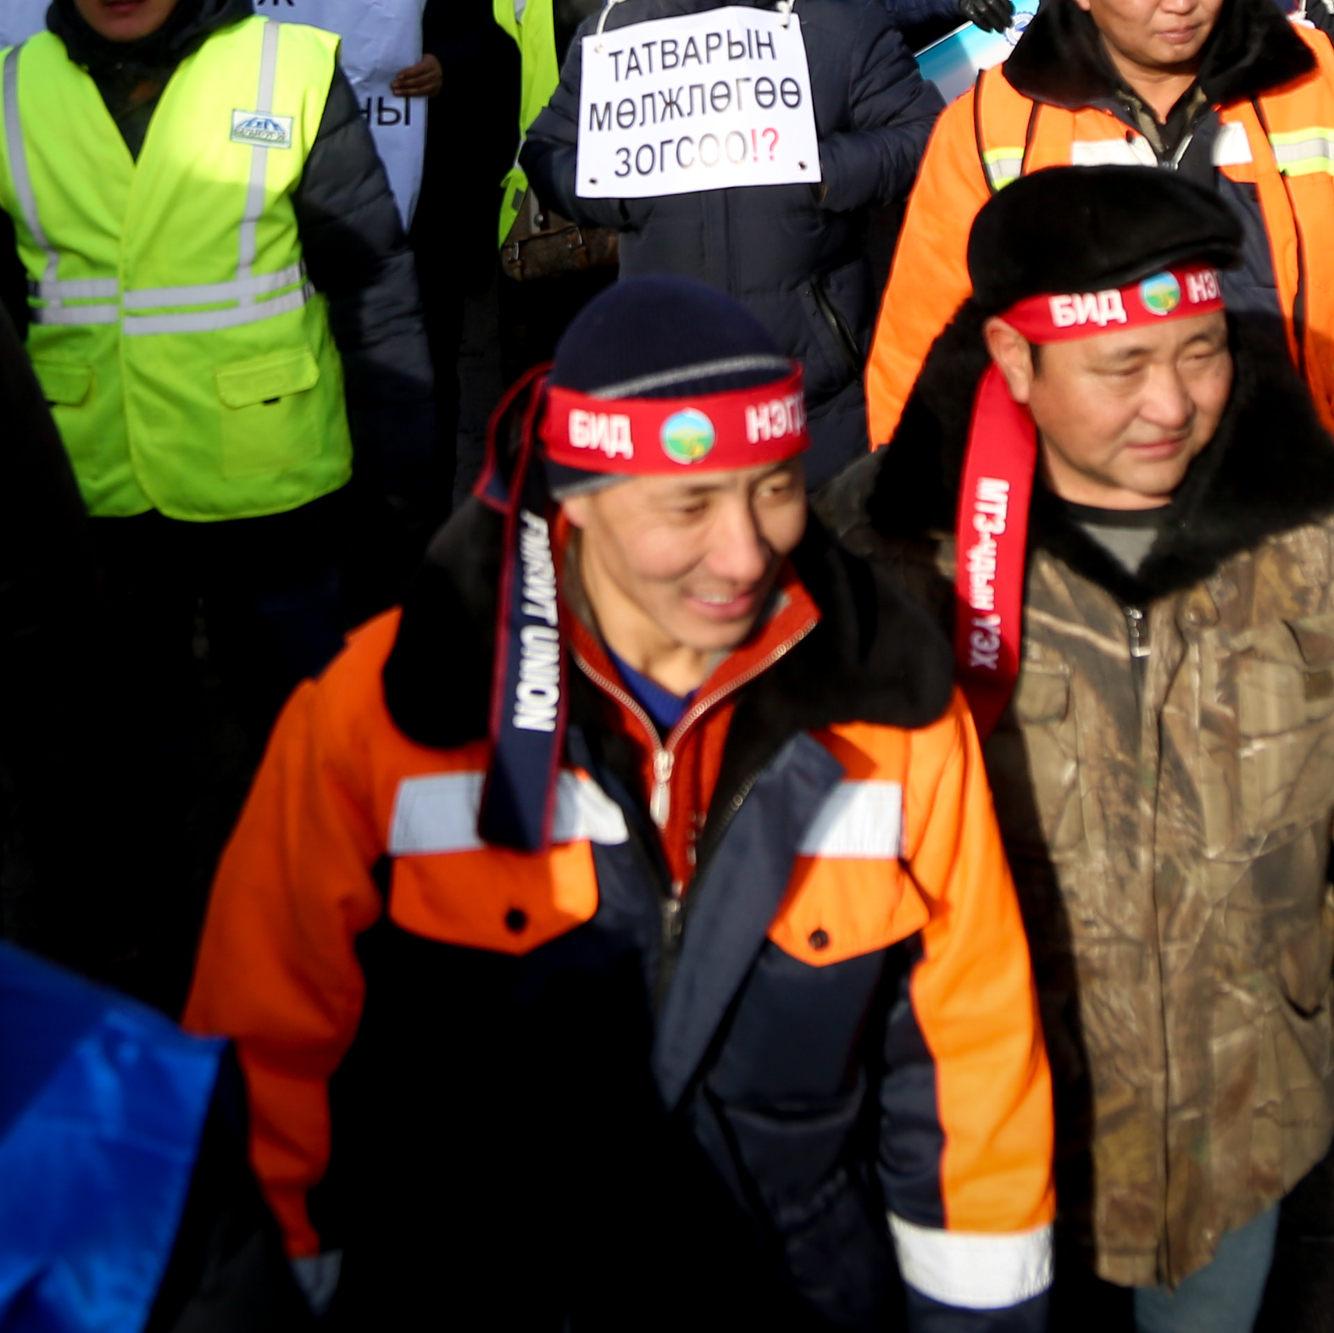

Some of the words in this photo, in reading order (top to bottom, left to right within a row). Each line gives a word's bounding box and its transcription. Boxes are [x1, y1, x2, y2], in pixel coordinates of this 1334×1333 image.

[608, 28, 777, 82] ТАТВАРЫН
[588, 76, 803, 132] МӨЛЖЛӨГӨӨ
[614, 127, 780, 178] ЗОГСОО!?
[1048, 288, 1128, 328] БИД
[567, 408, 635, 460] БИД
[512, 623, 560, 733] UNION
